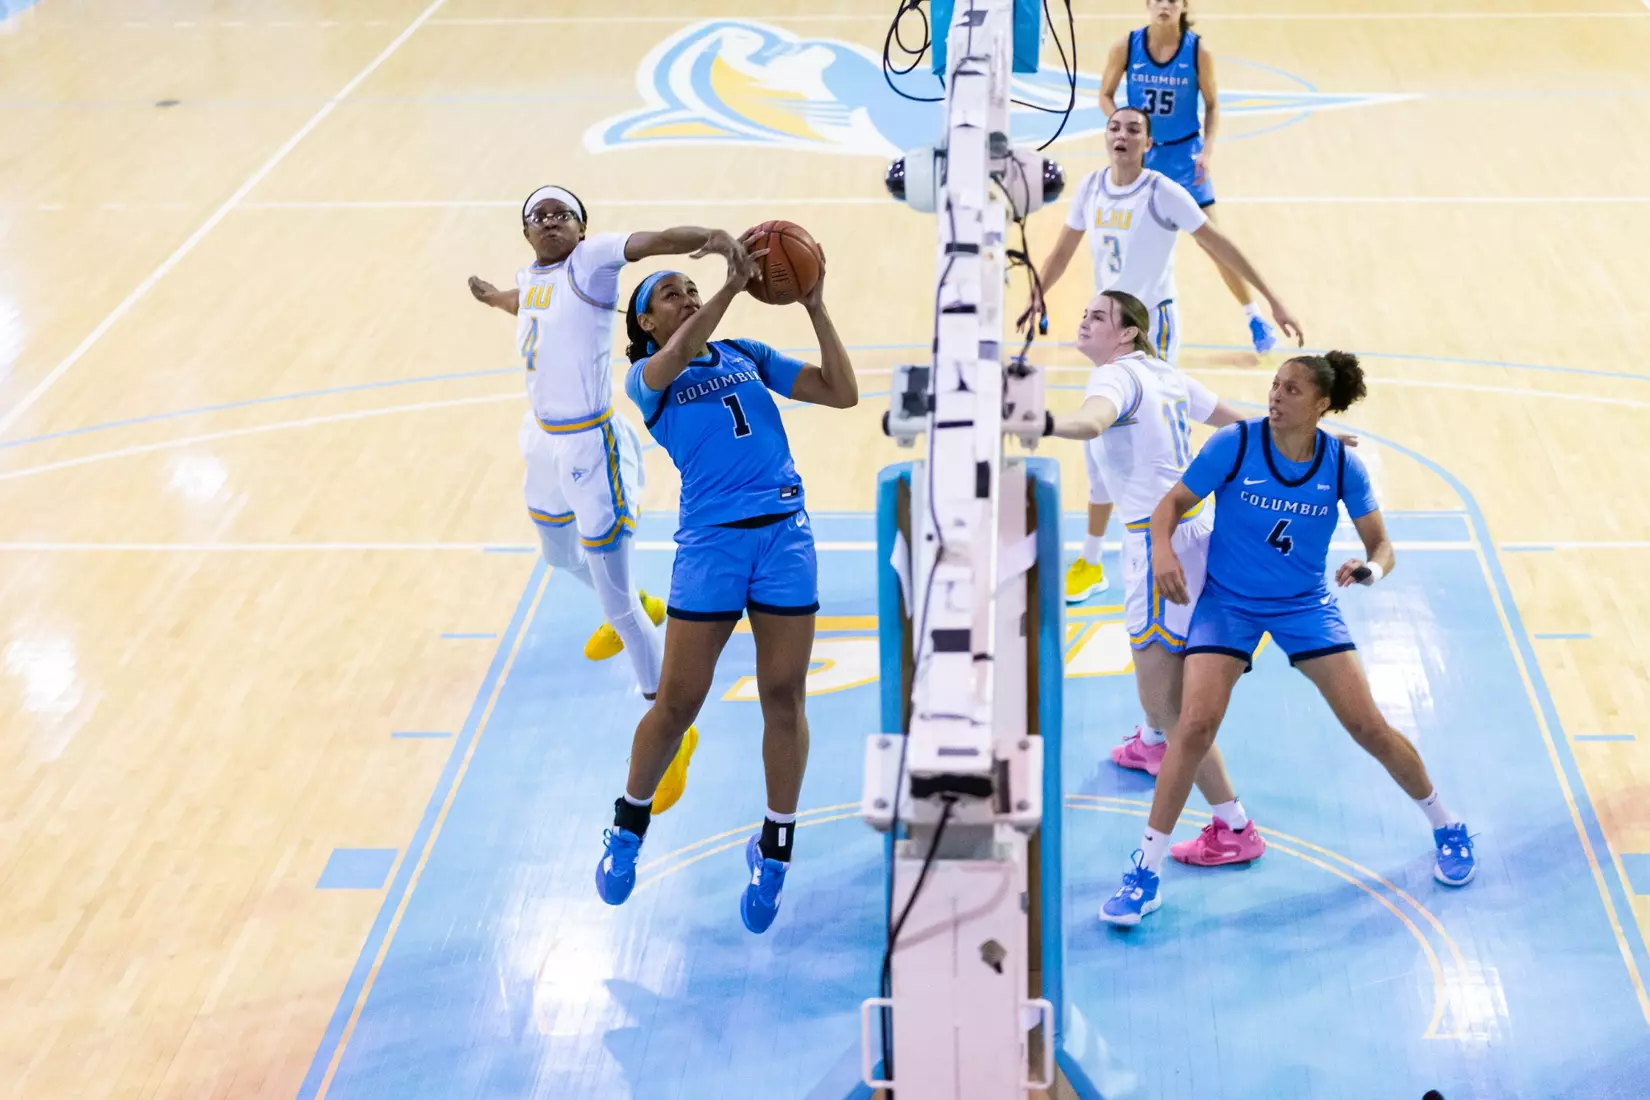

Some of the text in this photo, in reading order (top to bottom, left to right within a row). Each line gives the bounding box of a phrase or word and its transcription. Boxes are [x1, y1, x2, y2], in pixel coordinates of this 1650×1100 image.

[1131, 73, 1188, 86] COLUMBIA
[1141, 87, 1175, 117] 35
[1095, 207, 1132, 229] LIU
[1103, 234, 1122, 274] 3
[521, 316, 537, 371] 4
[676, 371, 762, 405] COLUMBIA
[721, 392, 752, 439] 1
[1240, 490, 1328, 516] COLUMBIA
[1264, 518, 1294, 556] 4
